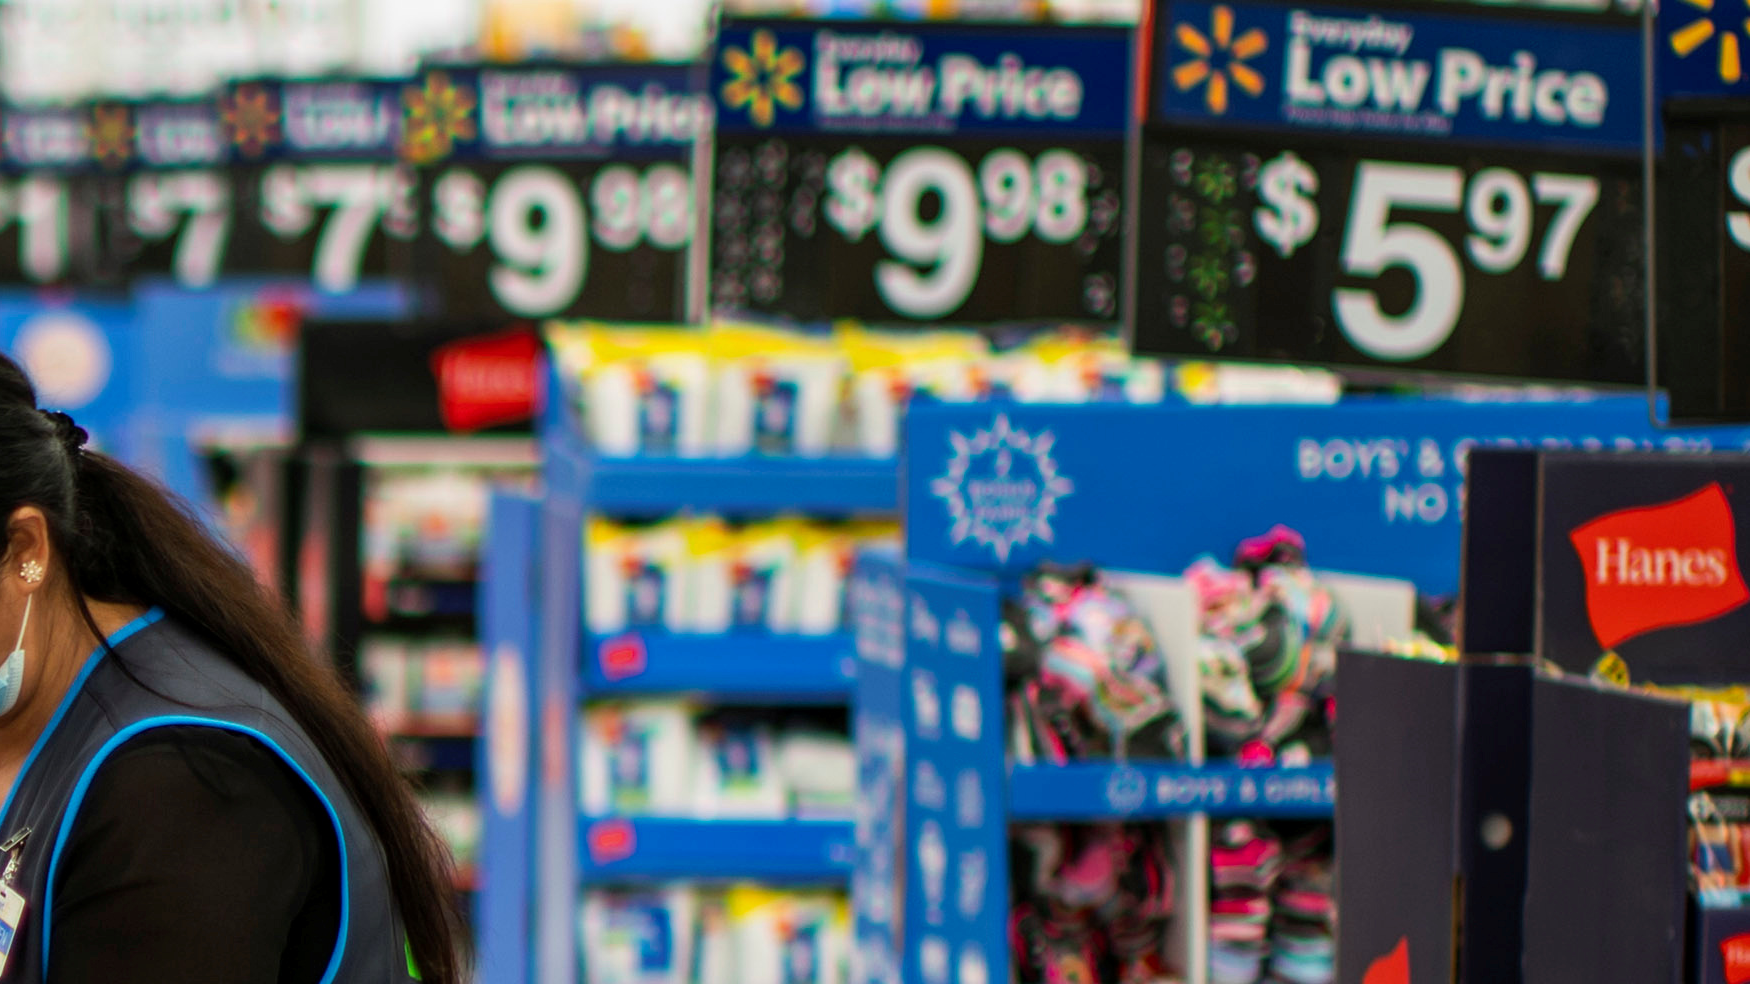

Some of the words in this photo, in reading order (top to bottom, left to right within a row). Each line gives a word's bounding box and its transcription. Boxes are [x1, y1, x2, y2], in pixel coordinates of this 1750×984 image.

[816, 52, 934, 116] Low
[940, 53, 1083, 118] Price
[1286, 37, 1430, 112] Low
[1439, 48, 1607, 125] Price
[1298, 438, 1409, 480] BOYS'
[1419, 439, 1444, 479] &
[1385, 483, 1448, 522] NO
[1595, 538, 1729, 588] Hanes
